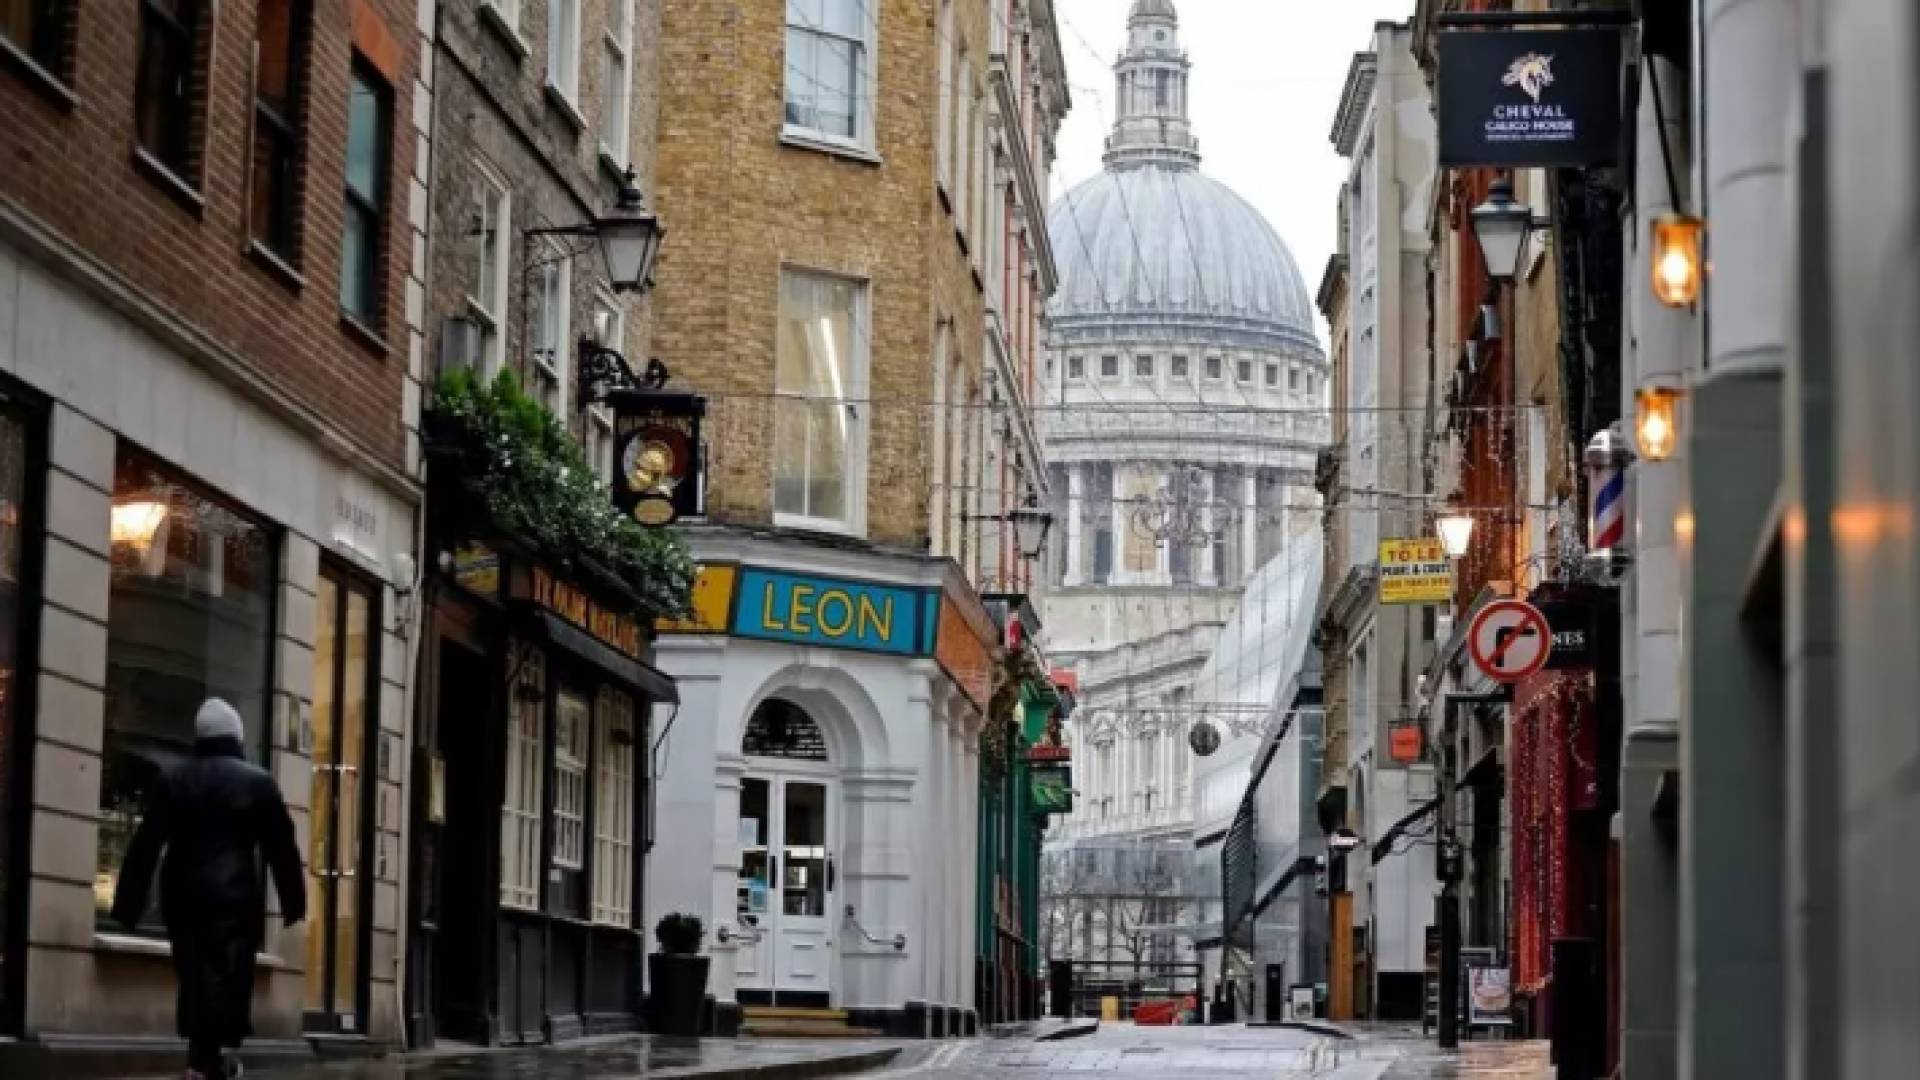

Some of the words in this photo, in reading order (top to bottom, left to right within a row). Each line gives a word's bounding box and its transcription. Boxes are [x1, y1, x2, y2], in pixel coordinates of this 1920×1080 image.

[1493, 104, 1566, 118] CHEVAL
[1485, 119, 1529, 131] CALICO
[1533, 119, 1574, 131] HOUSE
[1387, 549, 1410, 562] TO
[1417, 546, 1443, 561] LE
[762, 581, 895, 641] LEON
[1551, 631, 1585, 646] NES
